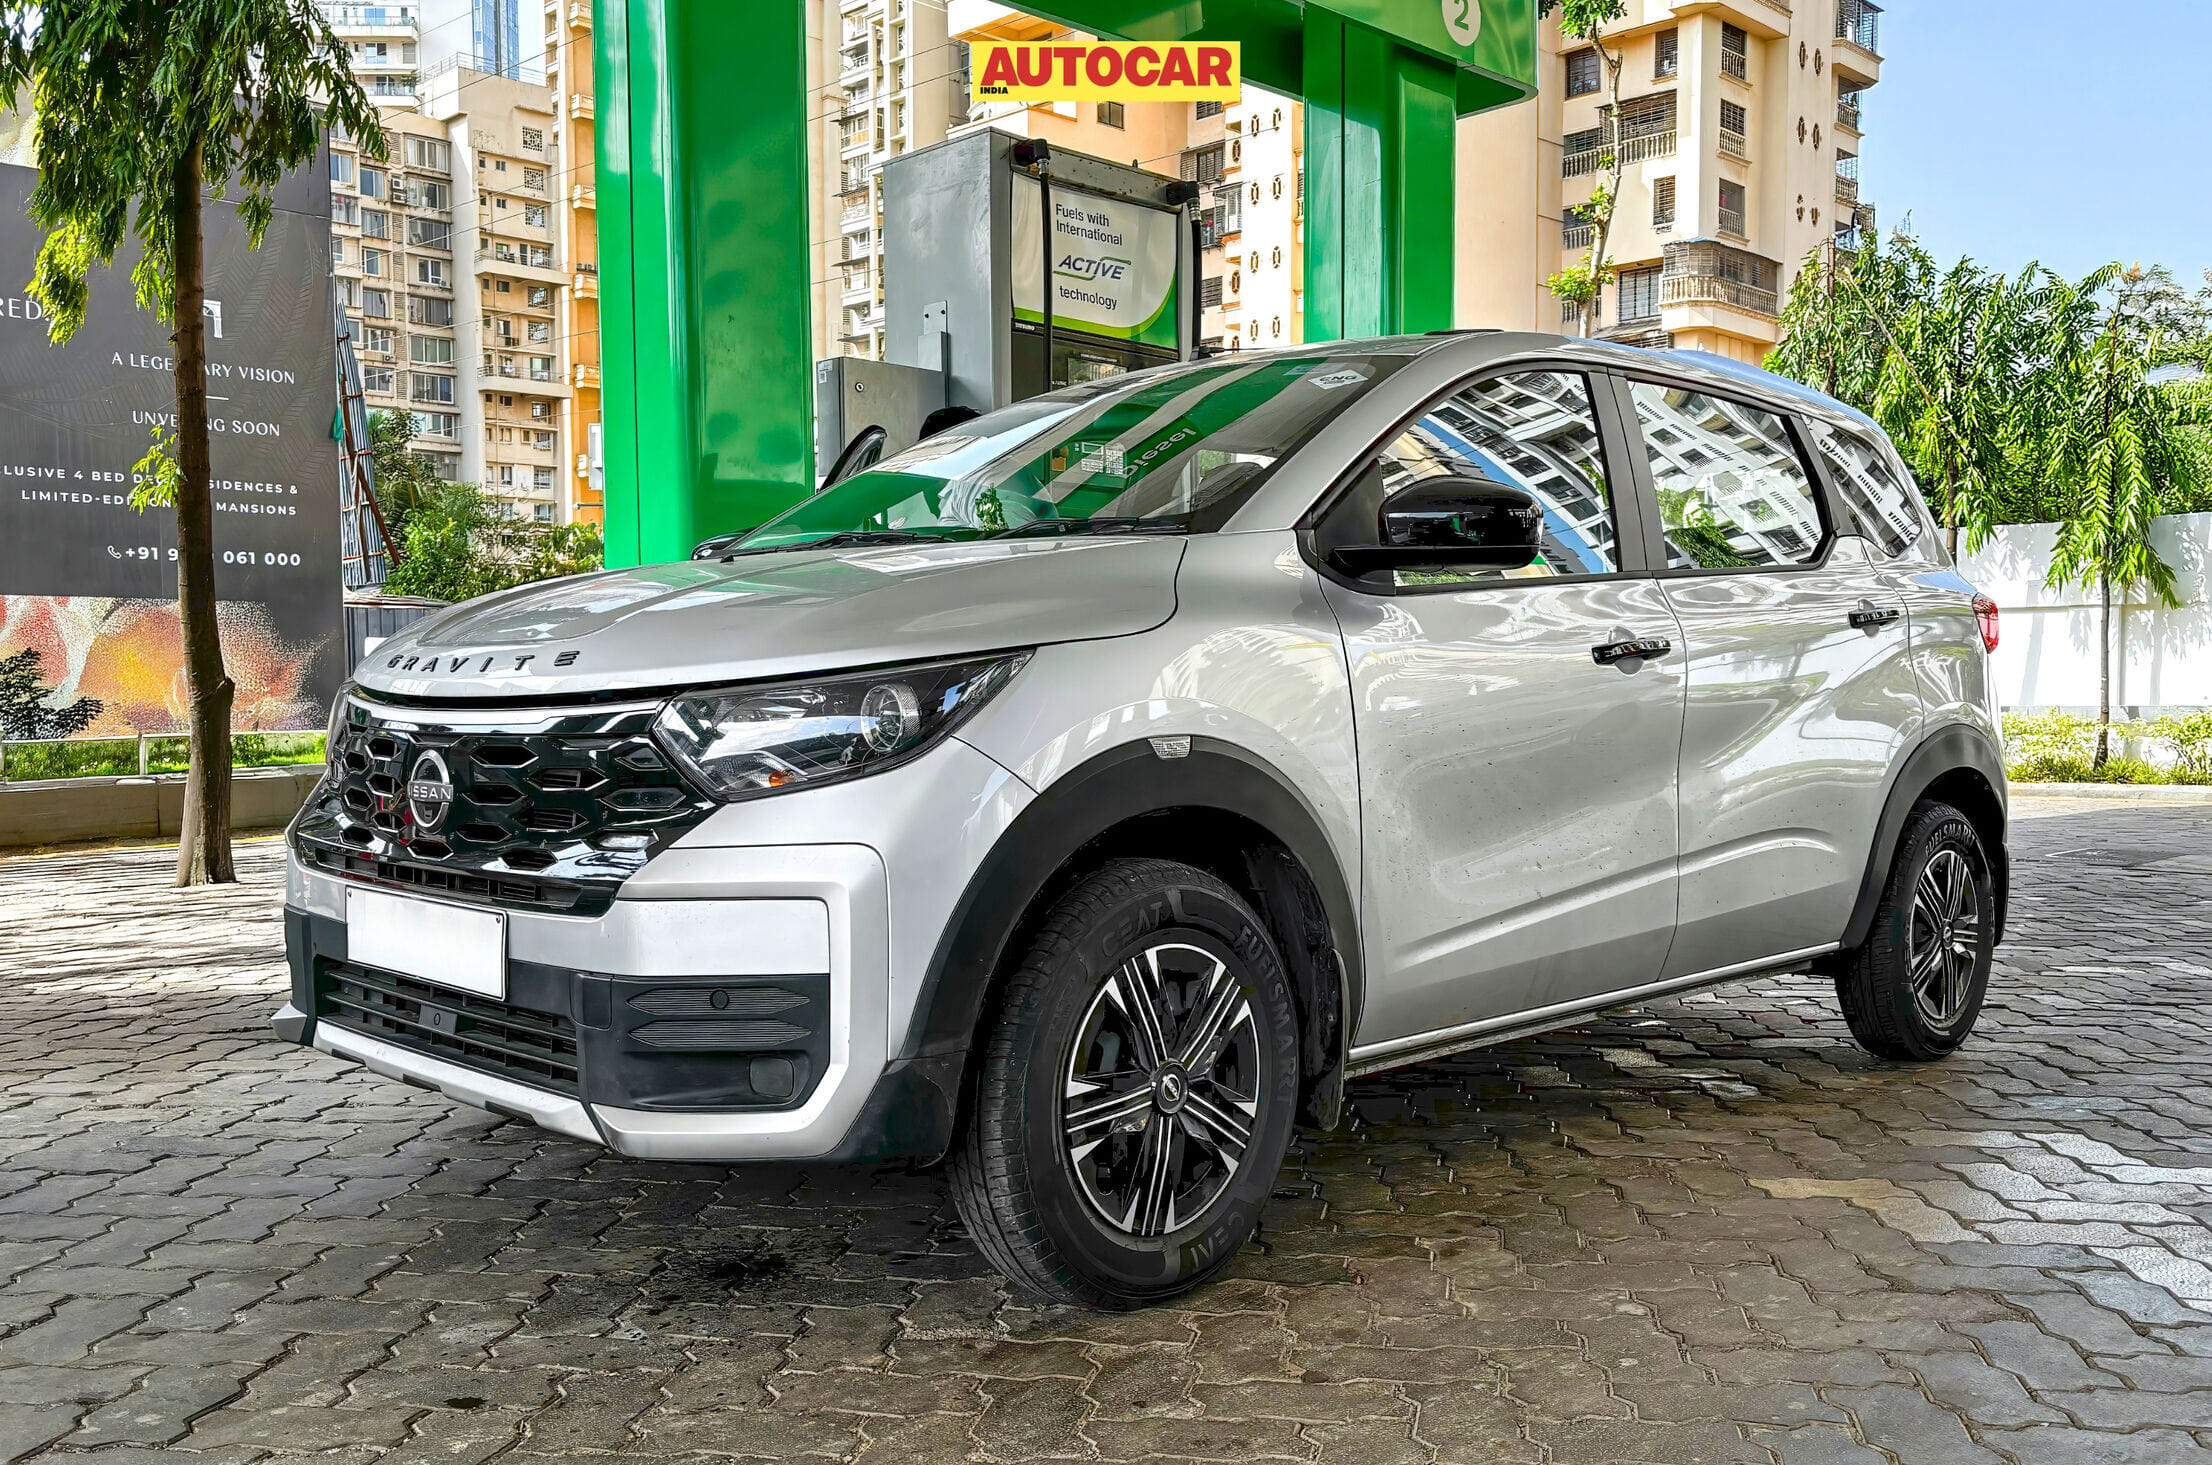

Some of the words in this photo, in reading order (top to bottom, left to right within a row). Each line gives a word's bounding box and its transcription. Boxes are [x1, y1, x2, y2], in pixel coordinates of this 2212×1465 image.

[1454, 0, 1469, 31] 2
[1055, 203, 1084, 222] Fuels
[1086, 212, 1110, 228] with
[1055, 219, 1123, 246] International
[1058, 254, 1125, 280] ACTIVE
[1059, 285, 1118, 311] technology
[111, 351, 124, 366] A
[238, 365, 296, 385] VISION
[231, 419, 281, 437] SOON
[73, 470, 84, 480] 4
[91, 471, 125, 483] BED
[289, 484, 298, 495] &
[215, 501, 297, 516] MANSIONS
[125, 546, 159, 561] +91
[222, 550, 256, 565] 061
[264, 552, 301, 566] 000
[386, 650, 581, 673] GRAVITE
[1925, 823, 1976, 859] FUELSMART
[1102, 901, 1163, 958] CEAT
